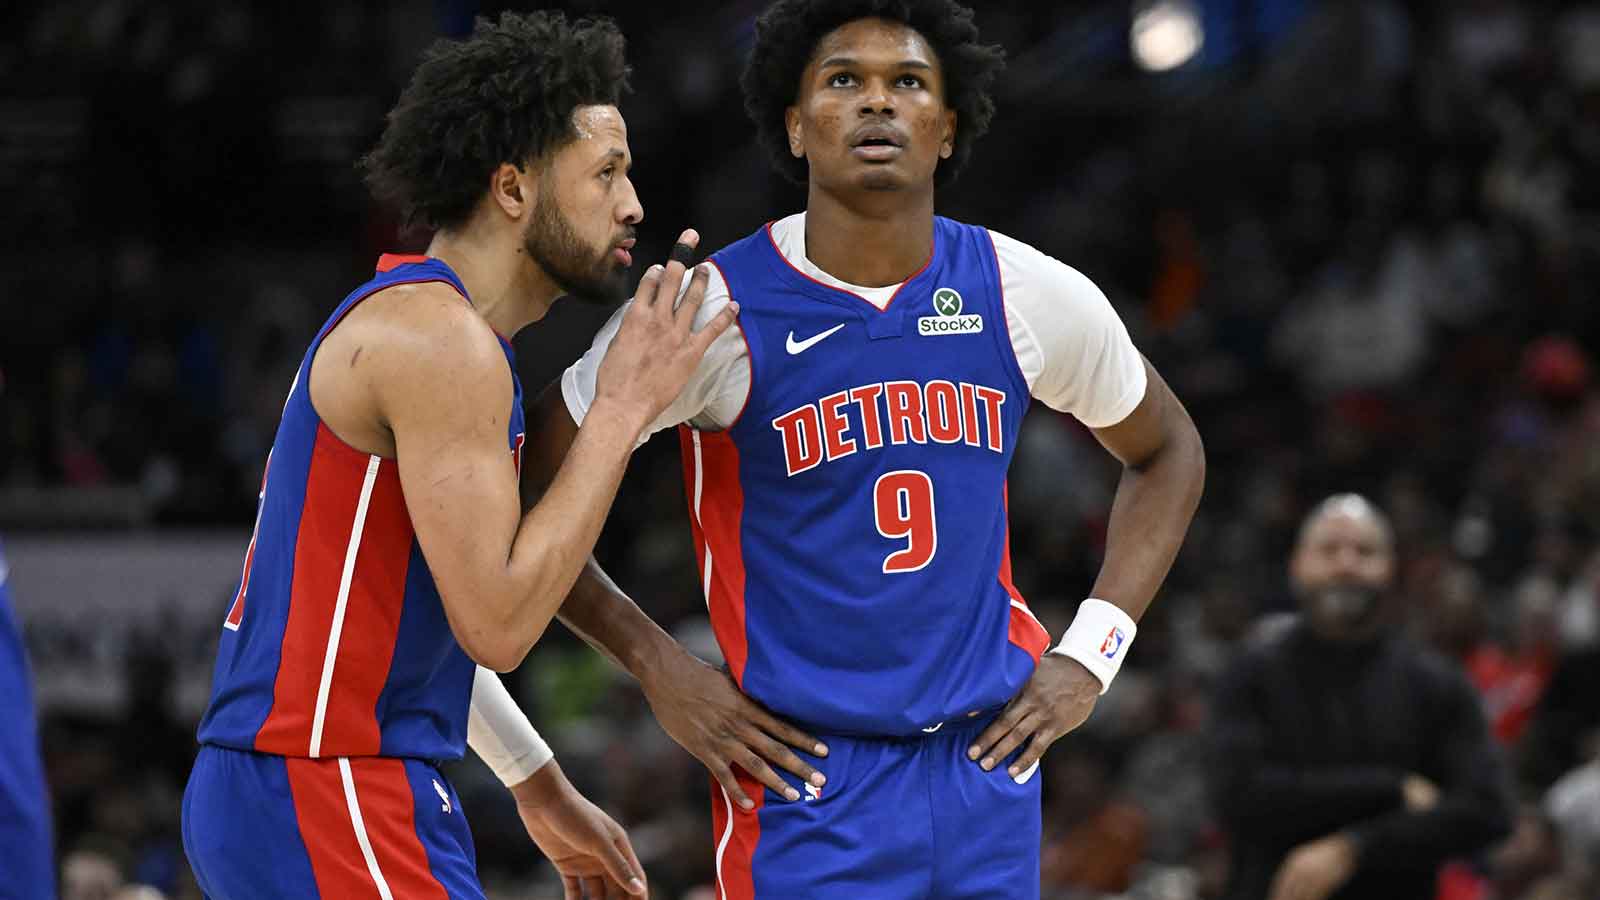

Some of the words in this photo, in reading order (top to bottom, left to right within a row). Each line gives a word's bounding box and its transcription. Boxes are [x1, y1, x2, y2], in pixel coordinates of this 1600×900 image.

[920, 317, 980, 332] StockX
[772, 379, 1006, 477] DETROIT
[873, 469, 938, 574] 9
